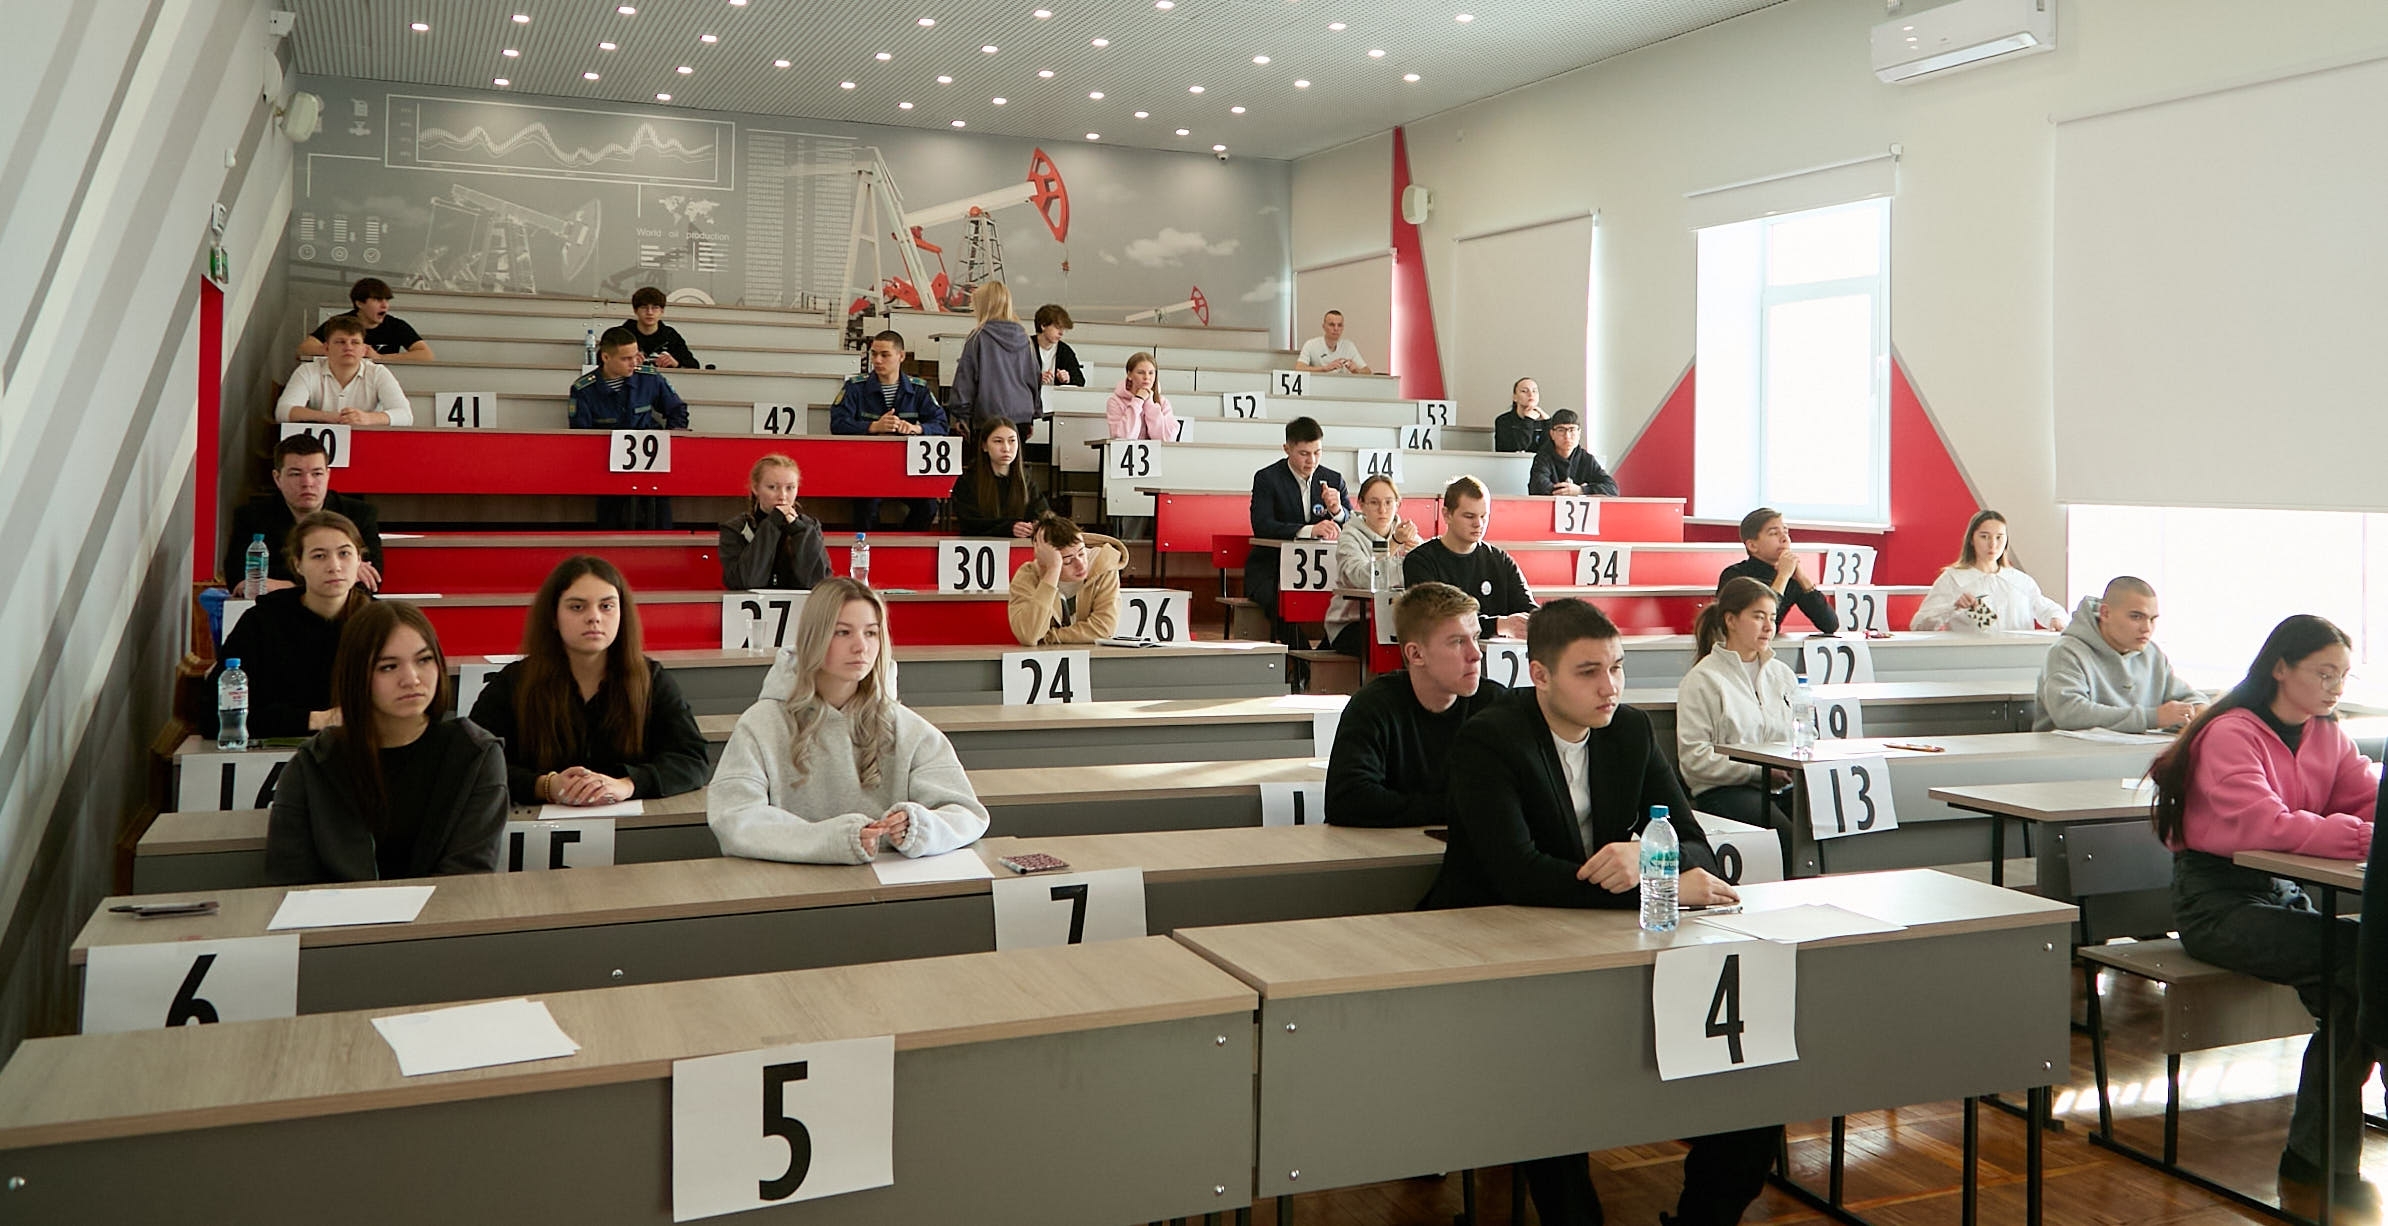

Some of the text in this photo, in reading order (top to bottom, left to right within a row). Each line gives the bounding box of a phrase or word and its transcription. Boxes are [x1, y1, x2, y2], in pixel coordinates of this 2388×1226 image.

[637, 227, 662, 238] World
[686, 231, 730, 242] production
[1281, 373, 1303, 396] 54
[447, 396, 480, 428] 41
[763, 406, 796, 434] 42
[1427, 403, 1447, 426] 53
[304, 427, 337, 468] 0
[622, 434, 659, 471] 39
[918, 440, 951, 474] 38
[1120, 444, 1151, 477] 43
[1367, 452, 1394, 478] 44
[1564, 500, 1591, 532] 37
[953, 545, 996, 590] 30
[1293, 548, 1329, 590] 35
[1586, 550, 1619, 586] 34
[1833, 551, 1862, 585] 33
[1129, 598, 1176, 642] 26
[1846, 592, 1880, 632] 32
[1020, 657, 1076, 705] 24
[1829, 765, 1877, 834] 13
[1704, 953, 1746, 1066] 4
[758, 1059, 813, 1202] 5
